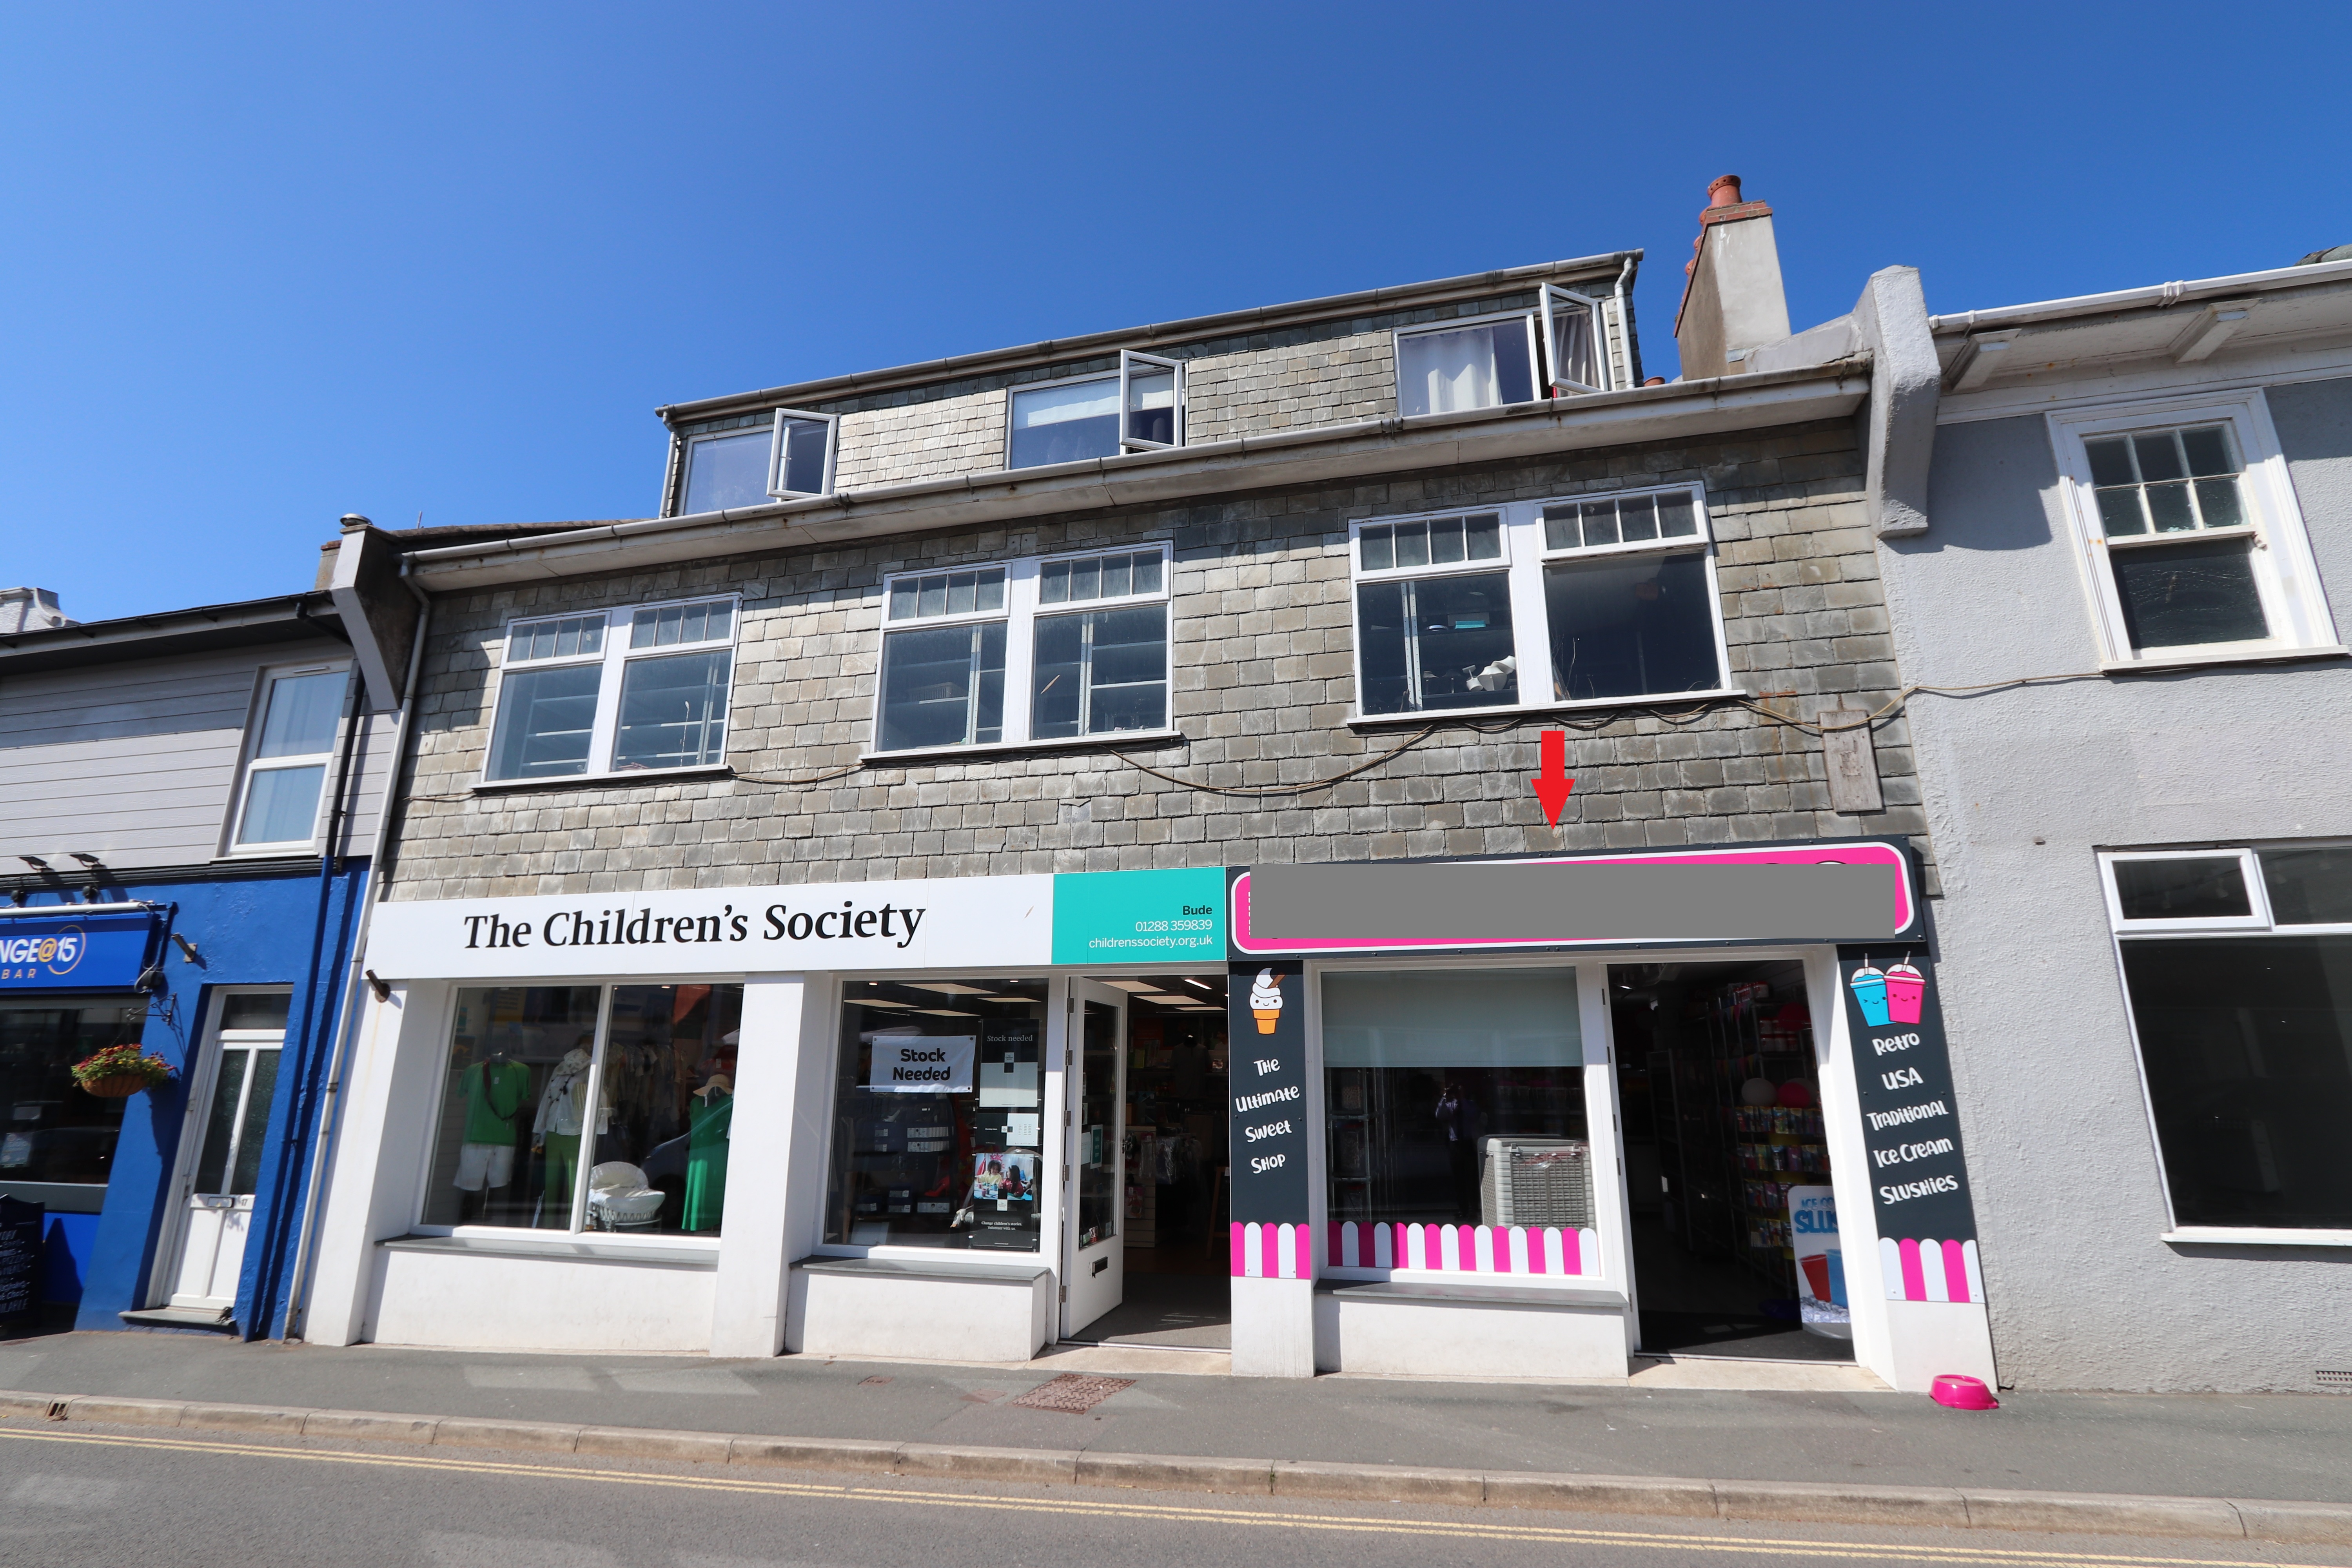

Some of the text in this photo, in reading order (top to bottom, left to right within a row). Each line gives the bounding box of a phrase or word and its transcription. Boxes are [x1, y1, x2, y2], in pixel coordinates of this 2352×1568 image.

[1182, 905, 1213, 916] Bude
[464, 901, 926, 949] The Children's Society
[1135, 919, 1213, 932] 01288 359839
[1089, 935, 1213, 948] childrenssociety.org.uk
[1, 969, 36, 979] BAR
[1872, 1033, 1920, 1056] Retro
[900, 1047, 946, 1062] Stock
[893, 1066, 951, 1081] Needed
[1881, 1067, 1924, 1090] USA
[1245, 1120, 1292, 1143] Sweet
[1873, 1149, 1900, 1168] Ice
